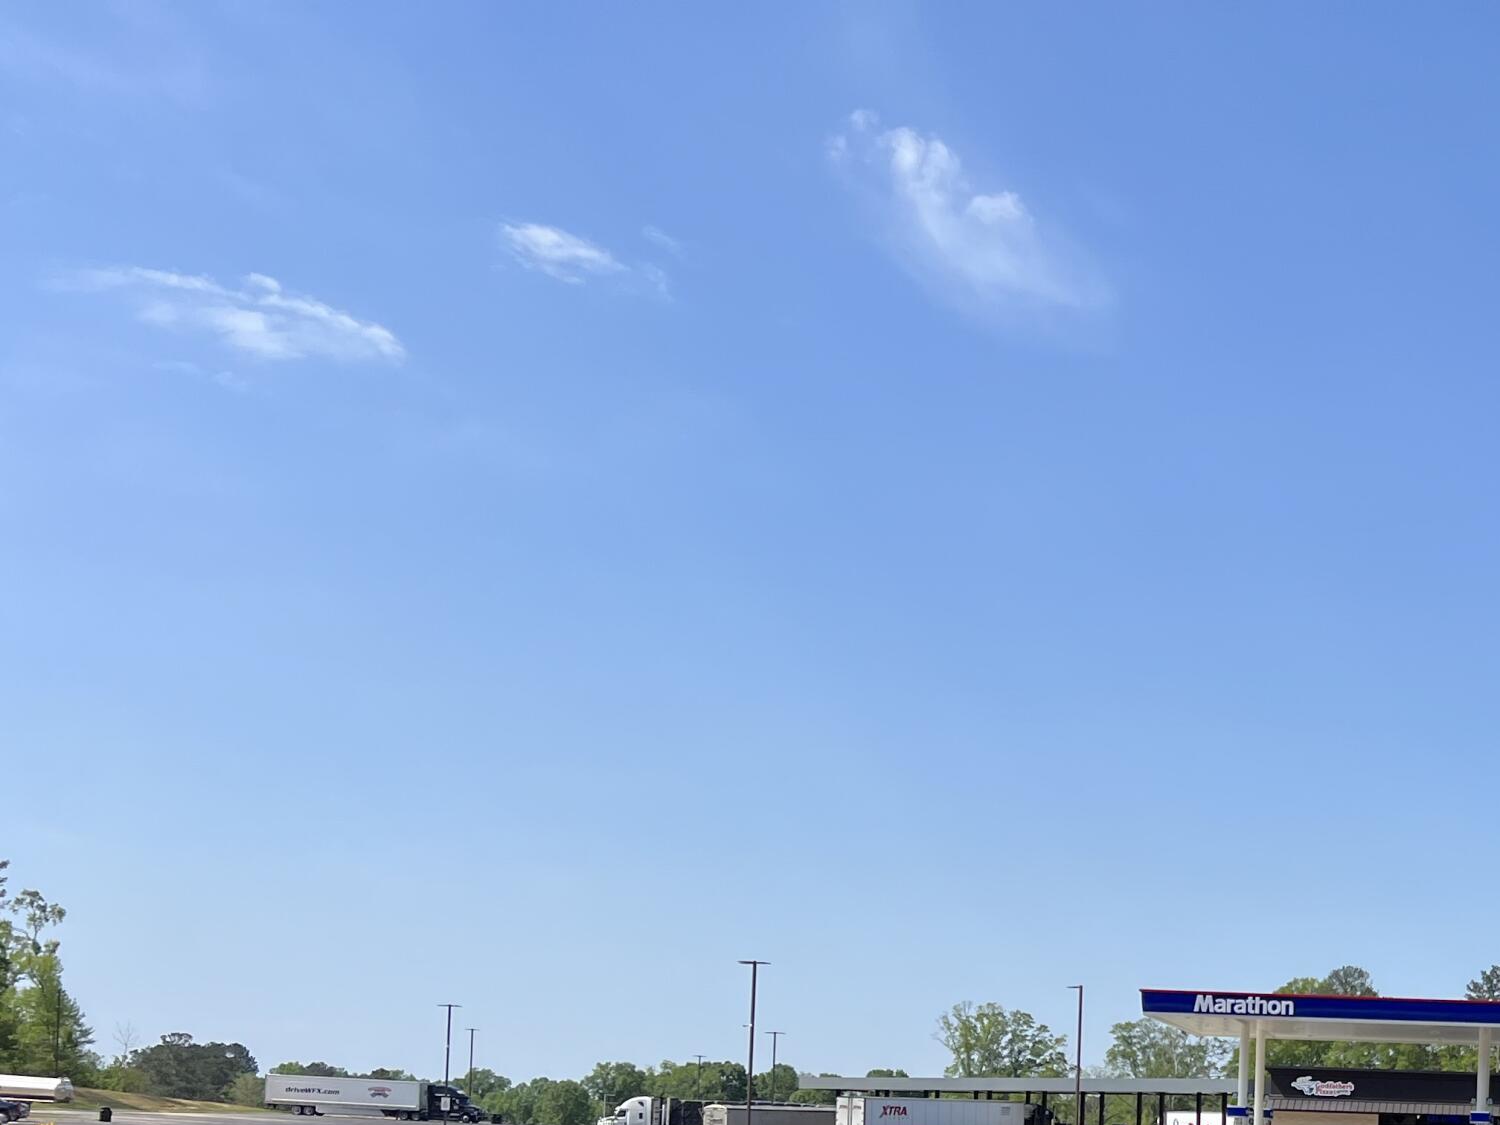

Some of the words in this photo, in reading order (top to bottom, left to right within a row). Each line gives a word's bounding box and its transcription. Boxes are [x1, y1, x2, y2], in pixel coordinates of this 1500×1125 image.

[1193, 994, 1295, 1016] Marathon
[285, 1086, 340, 1096] driveWFX.com
[880, 1105, 908, 1118] XTRA
